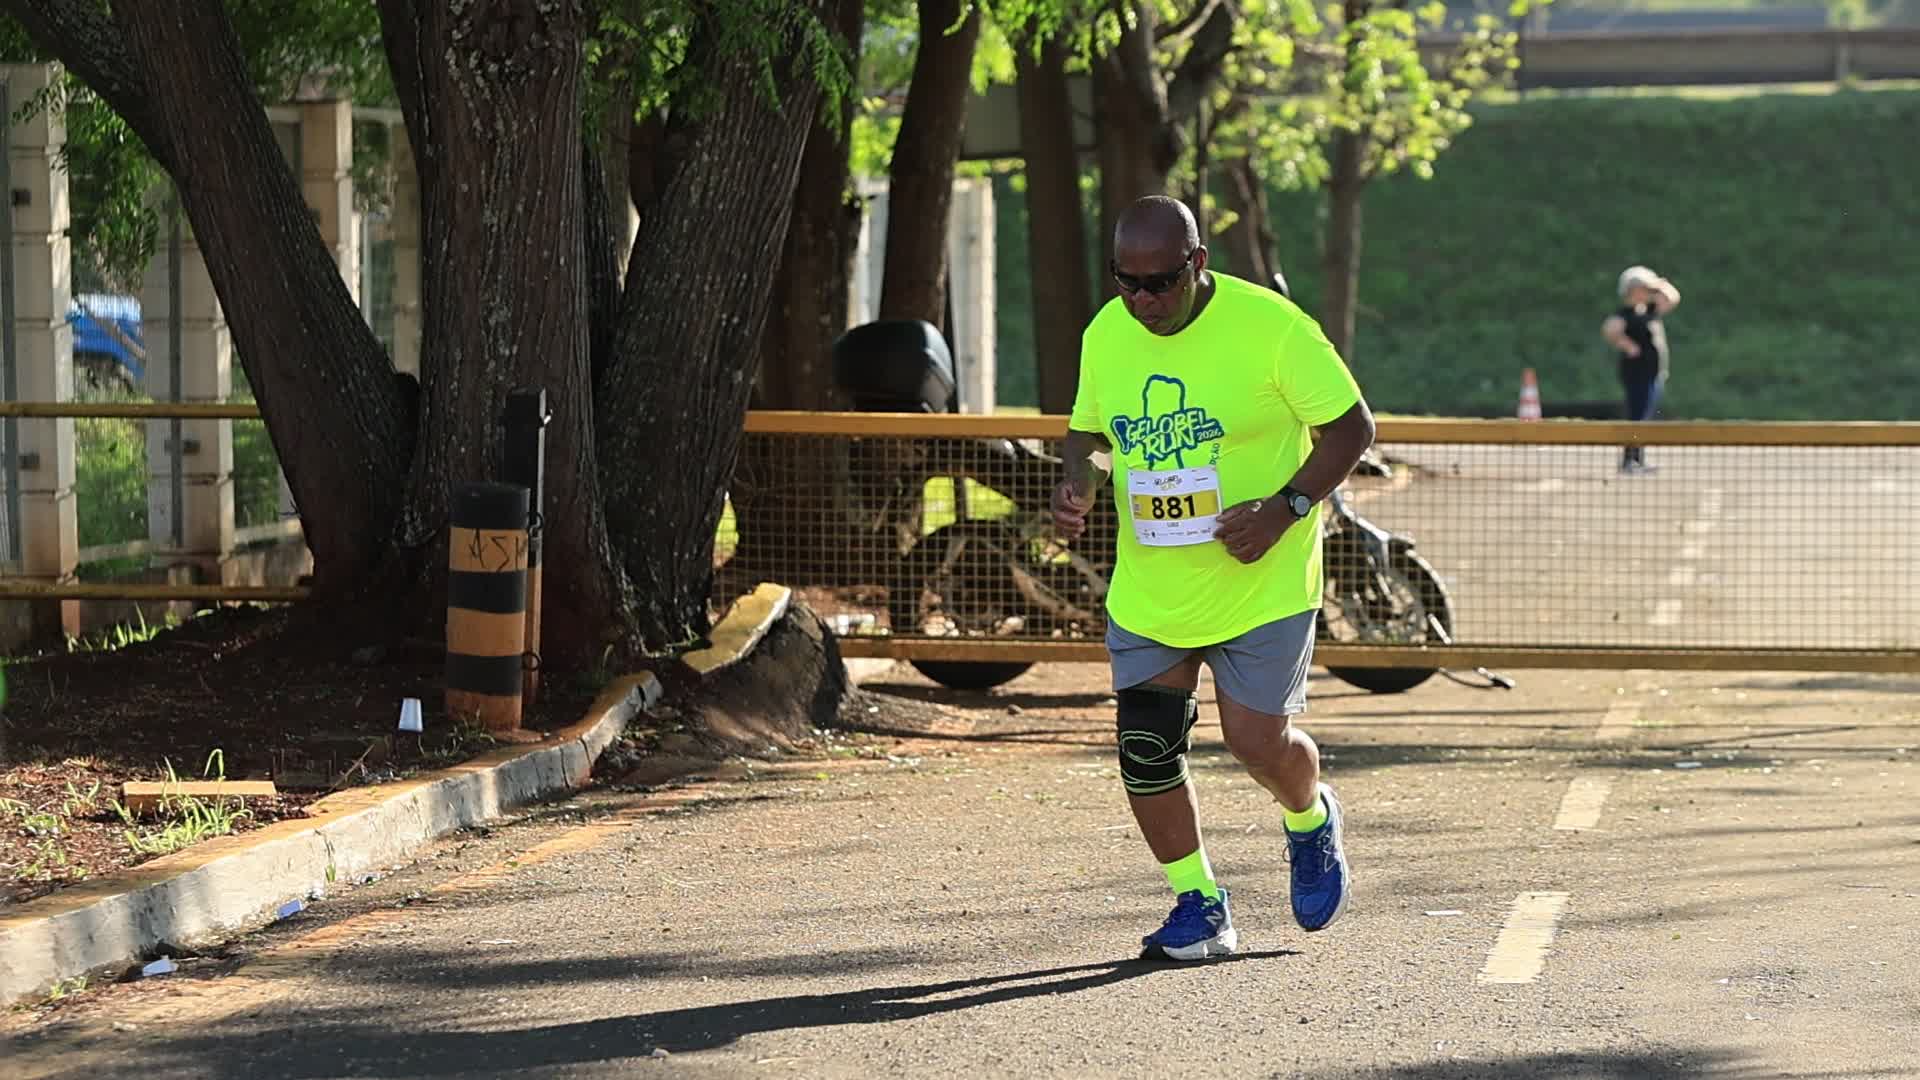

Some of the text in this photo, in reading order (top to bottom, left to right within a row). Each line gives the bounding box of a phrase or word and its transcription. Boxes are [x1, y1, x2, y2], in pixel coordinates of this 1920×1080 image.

[1127, 411, 1216, 443] GELOBEL
[1144, 428, 1196, 459] RUN
[1151, 495, 1195, 519] 881
